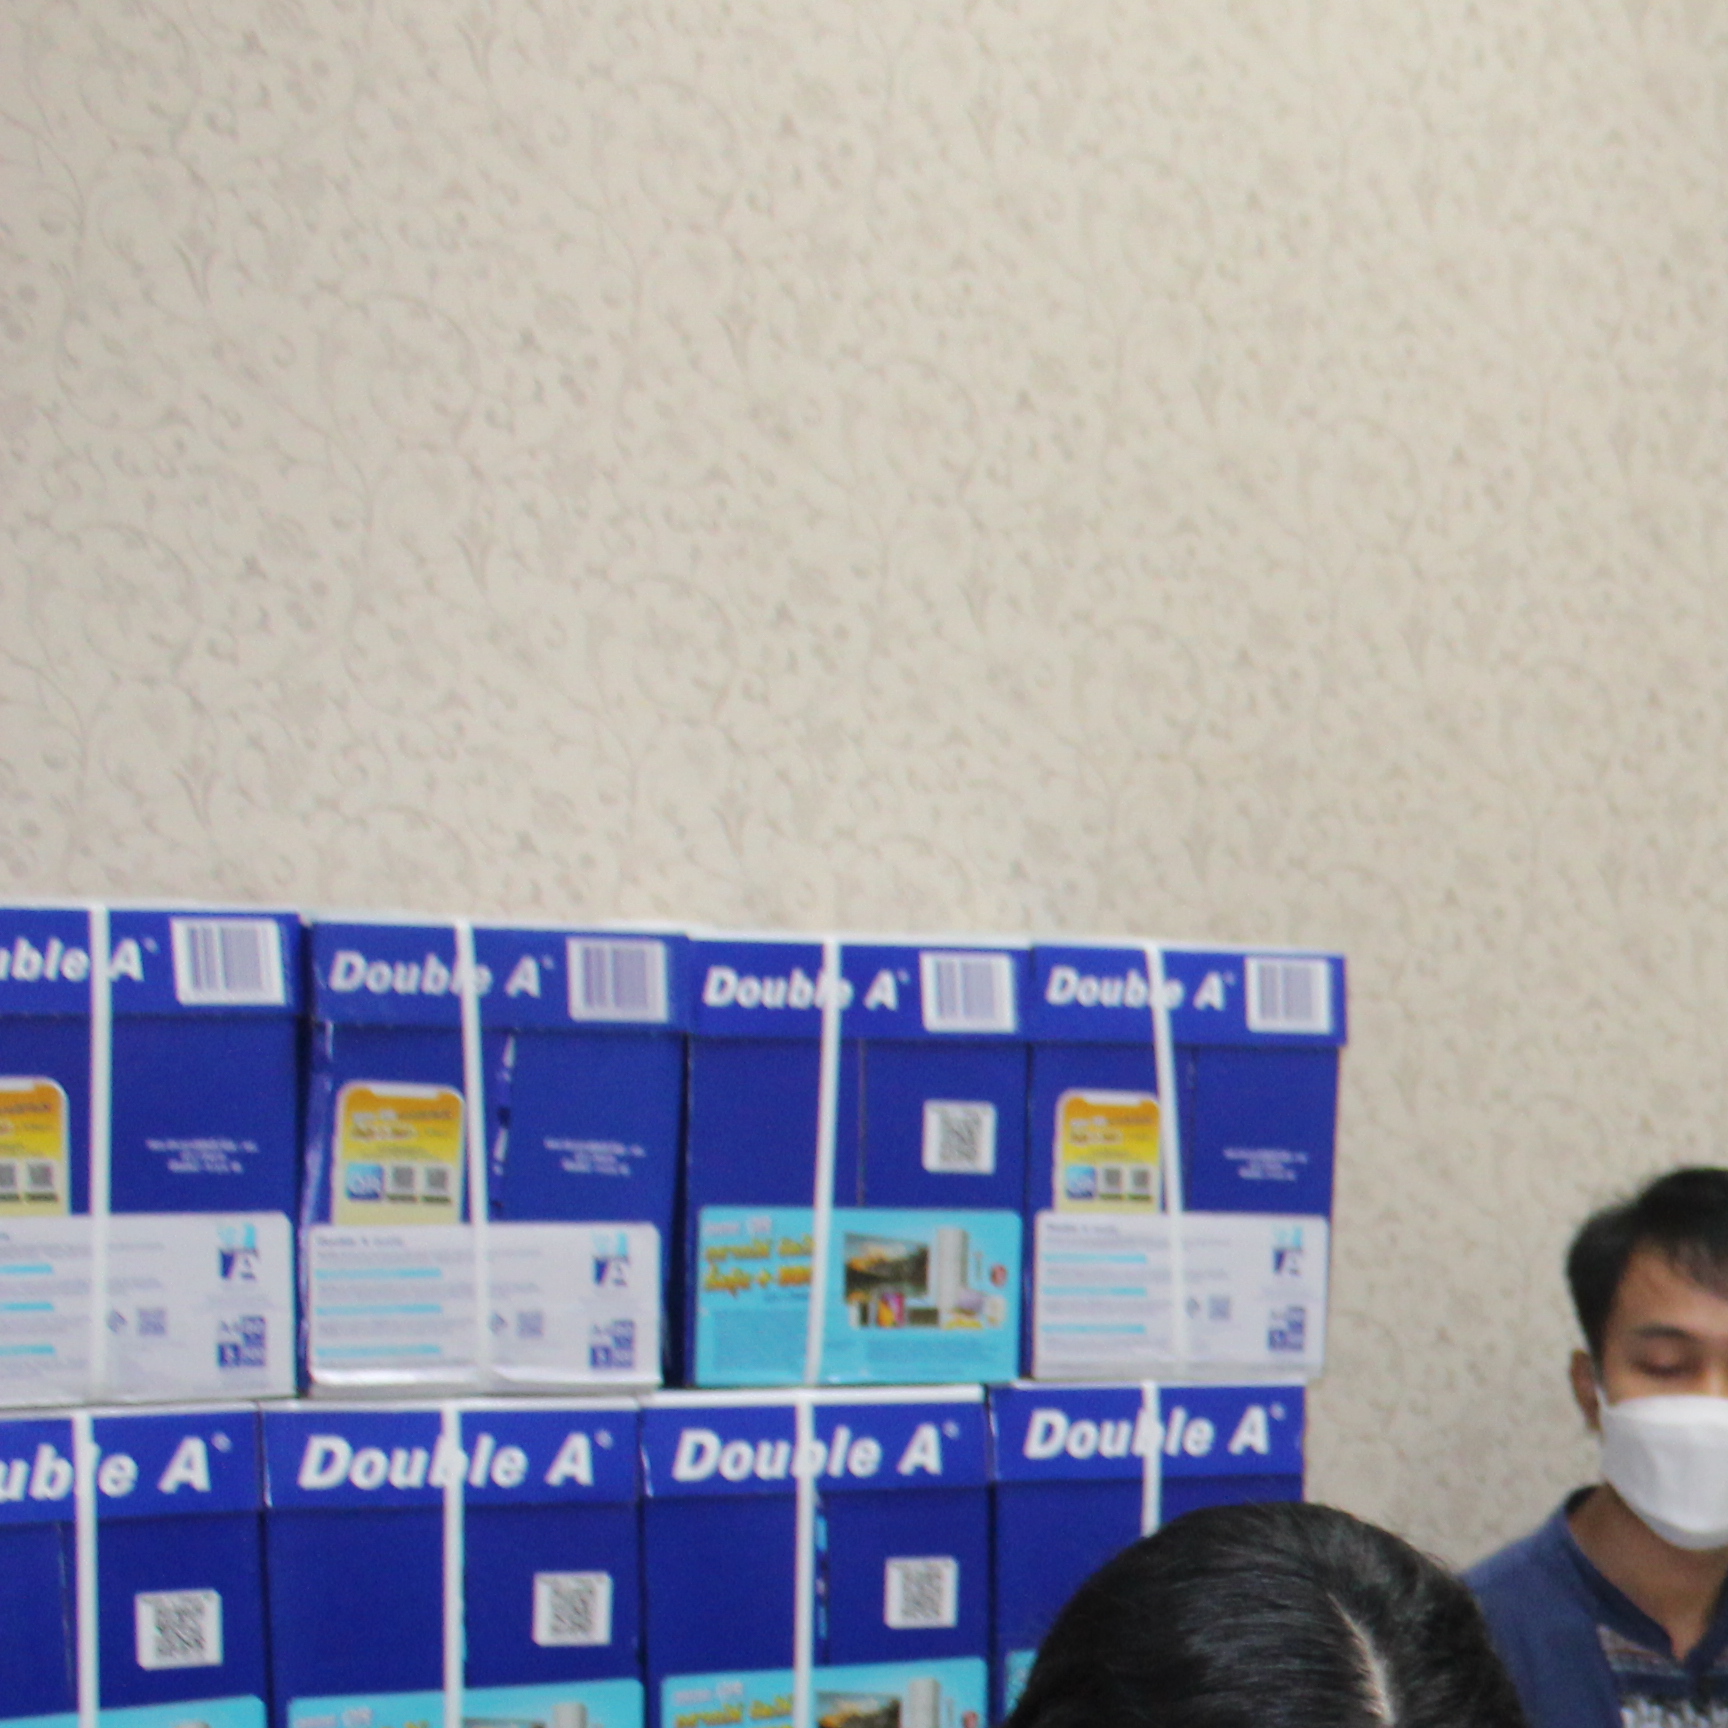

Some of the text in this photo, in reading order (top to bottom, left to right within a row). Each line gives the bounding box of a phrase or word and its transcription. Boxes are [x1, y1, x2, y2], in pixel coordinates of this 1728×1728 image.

[110, 938, 145, 981] A
[506, 955, 541, 998] A
[863, 968, 898, 1011] A
[1192, 971, 1226, 1011] A
[896, 1421, 943, 1477] A
[1227, 1404, 1270, 1456] A
[156, 1435, 212, 1494] A
[545, 1431, 594, 1487] A
